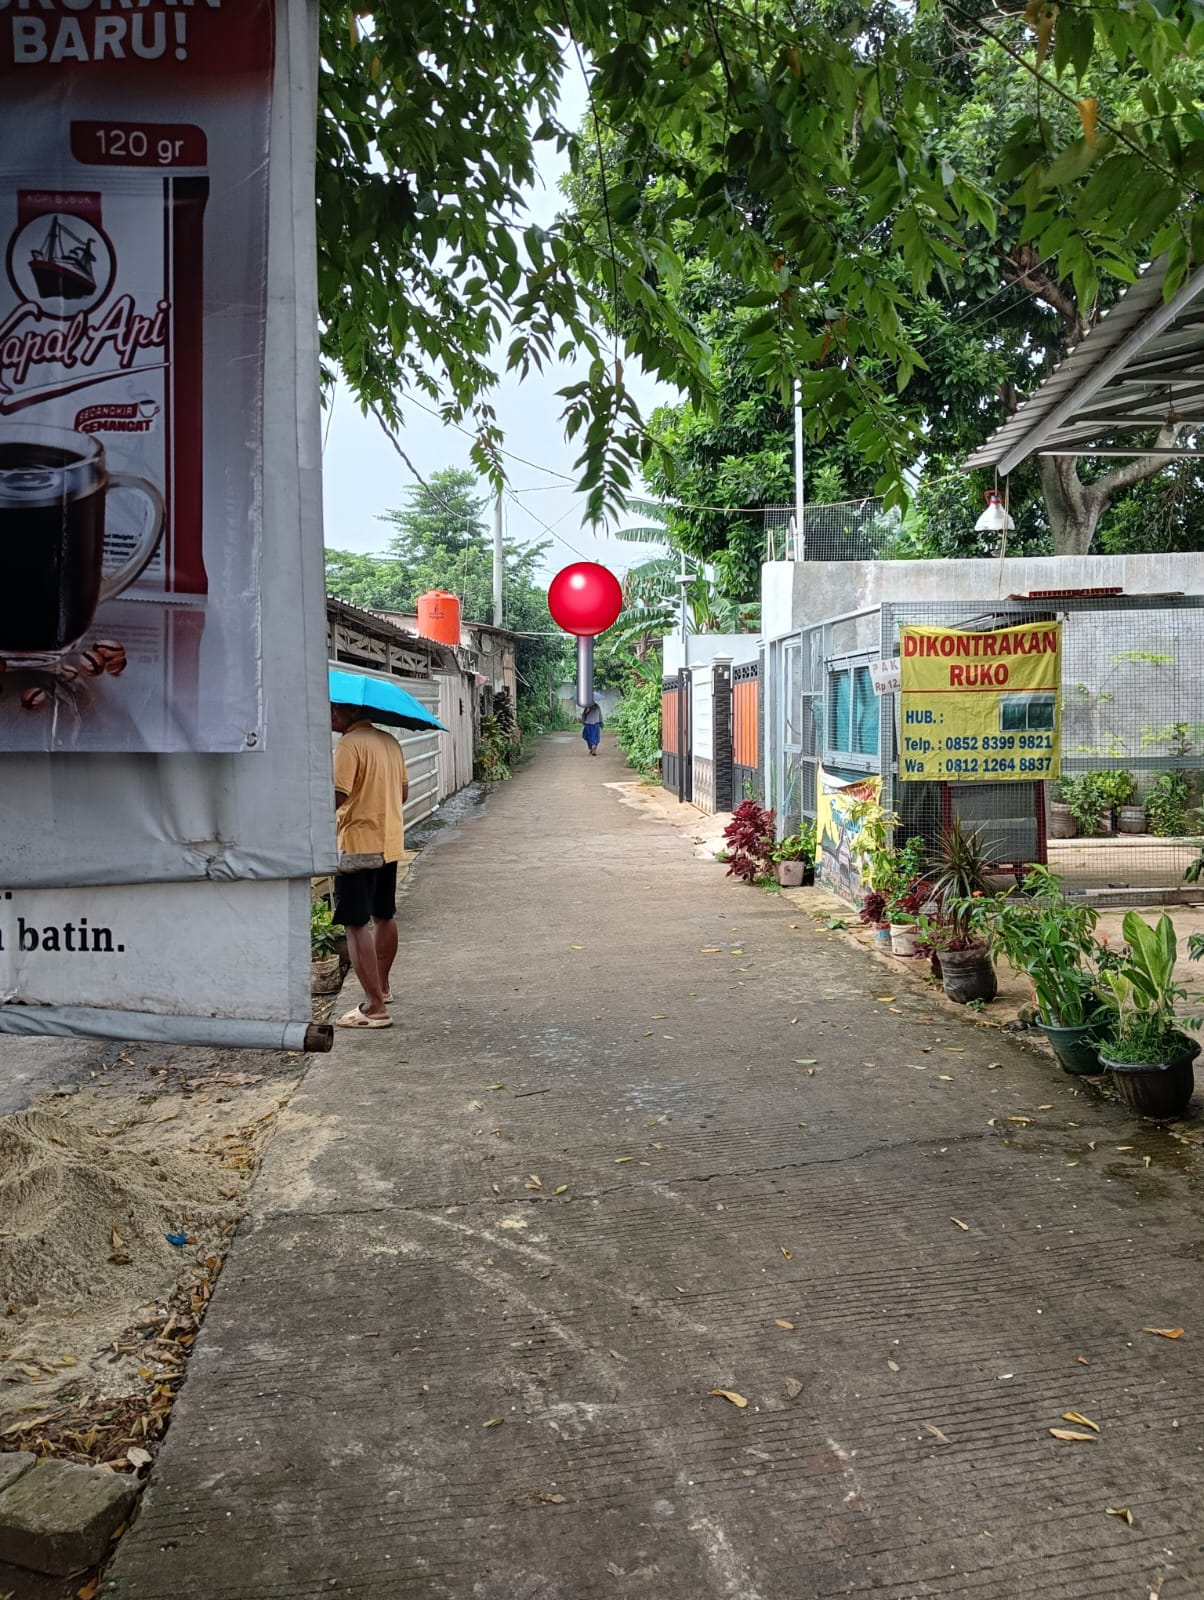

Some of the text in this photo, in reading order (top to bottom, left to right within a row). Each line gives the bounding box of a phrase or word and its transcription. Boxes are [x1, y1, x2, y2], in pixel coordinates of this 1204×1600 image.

[12, 11, 187, 63] BARU!
[96, 129, 185, 165] 120 gr
[80, 293, 171, 369] Api
[903, 631, 1057, 658] DIKONTRAKAN
[874, 681, 887, 693] Rp
[949, 663, 1010, 687] RUKO
[905, 710, 937, 724] HUB.
[904, 737, 935, 754] Telp.
[945, 737, 978, 751] 0852
[982, 736, 1015, 750] 8399
[1018, 735, 1053, 749] 9821
[904, 759, 925, 773] Wa
[945, 758, 978, 772] 0812
[982, 758, 1016, 772] 1264
[1018, 757, 1052, 771] 8837
[16, 917, 125, 952] batin.
